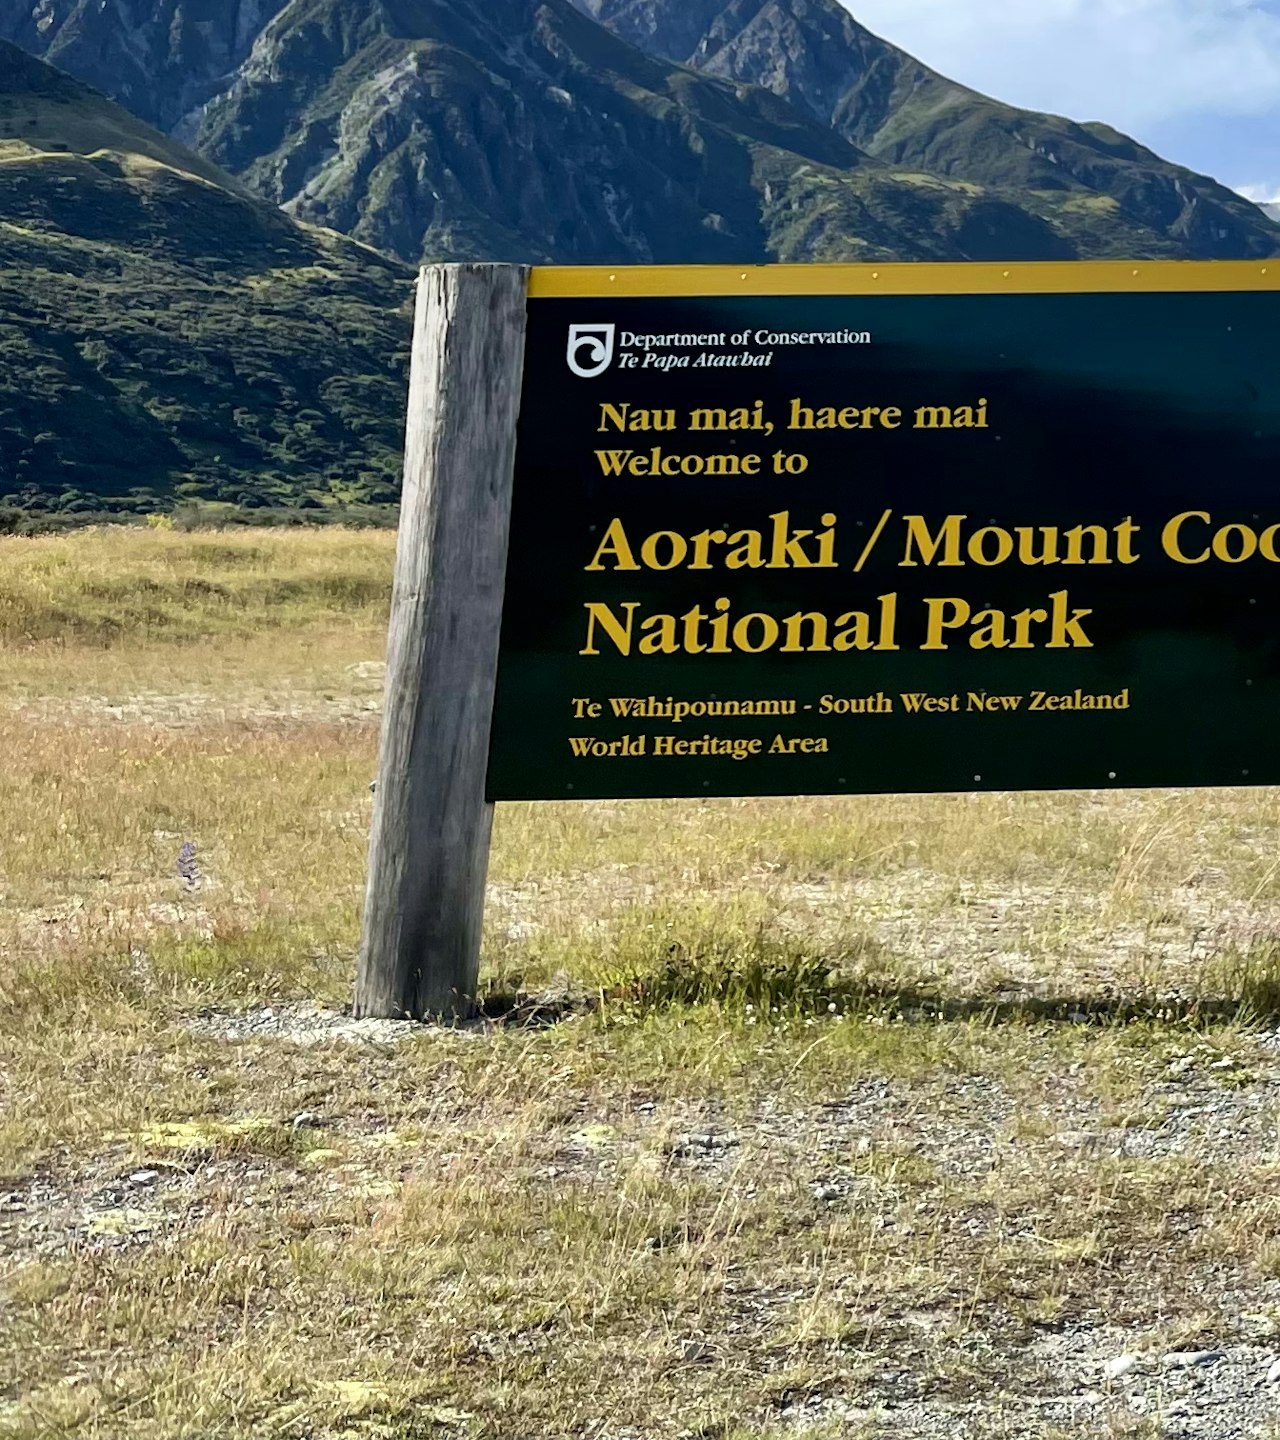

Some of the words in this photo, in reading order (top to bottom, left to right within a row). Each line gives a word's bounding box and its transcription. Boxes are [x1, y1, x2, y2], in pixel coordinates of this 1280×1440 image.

[619, 331, 726, 350] Department
[730, 329, 752, 346] of
[754, 328, 871, 345] Conservation
[618, 352, 639, 369] Te
[641, 352, 690, 372] Papa
[596, 403, 677, 433] Nau
[687, 399, 774, 436] mai,
[786, 397, 902, 430] haere
[912, 397, 989, 429] mai
[593, 446, 762, 477] Welcome
[771, 449, 809, 475] to
[583, 510, 839, 571] Aoraki
[897, 514, 1141, 567] Mount
[578, 591, 900, 657] National
[919, 589, 1095, 650] Park
[571, 697, 603, 719] Te
[607, 695, 796, 723] Wāhipounamu
[818, 691, 893, 715] South
[899, 693, 960, 713] West
[966, 692, 1023, 712] New
[1027, 688, 1130, 711] Zealand
[567, 734, 646, 757] World
[652, 734, 763, 761] Heritage
[768, 733, 829, 754] Area
